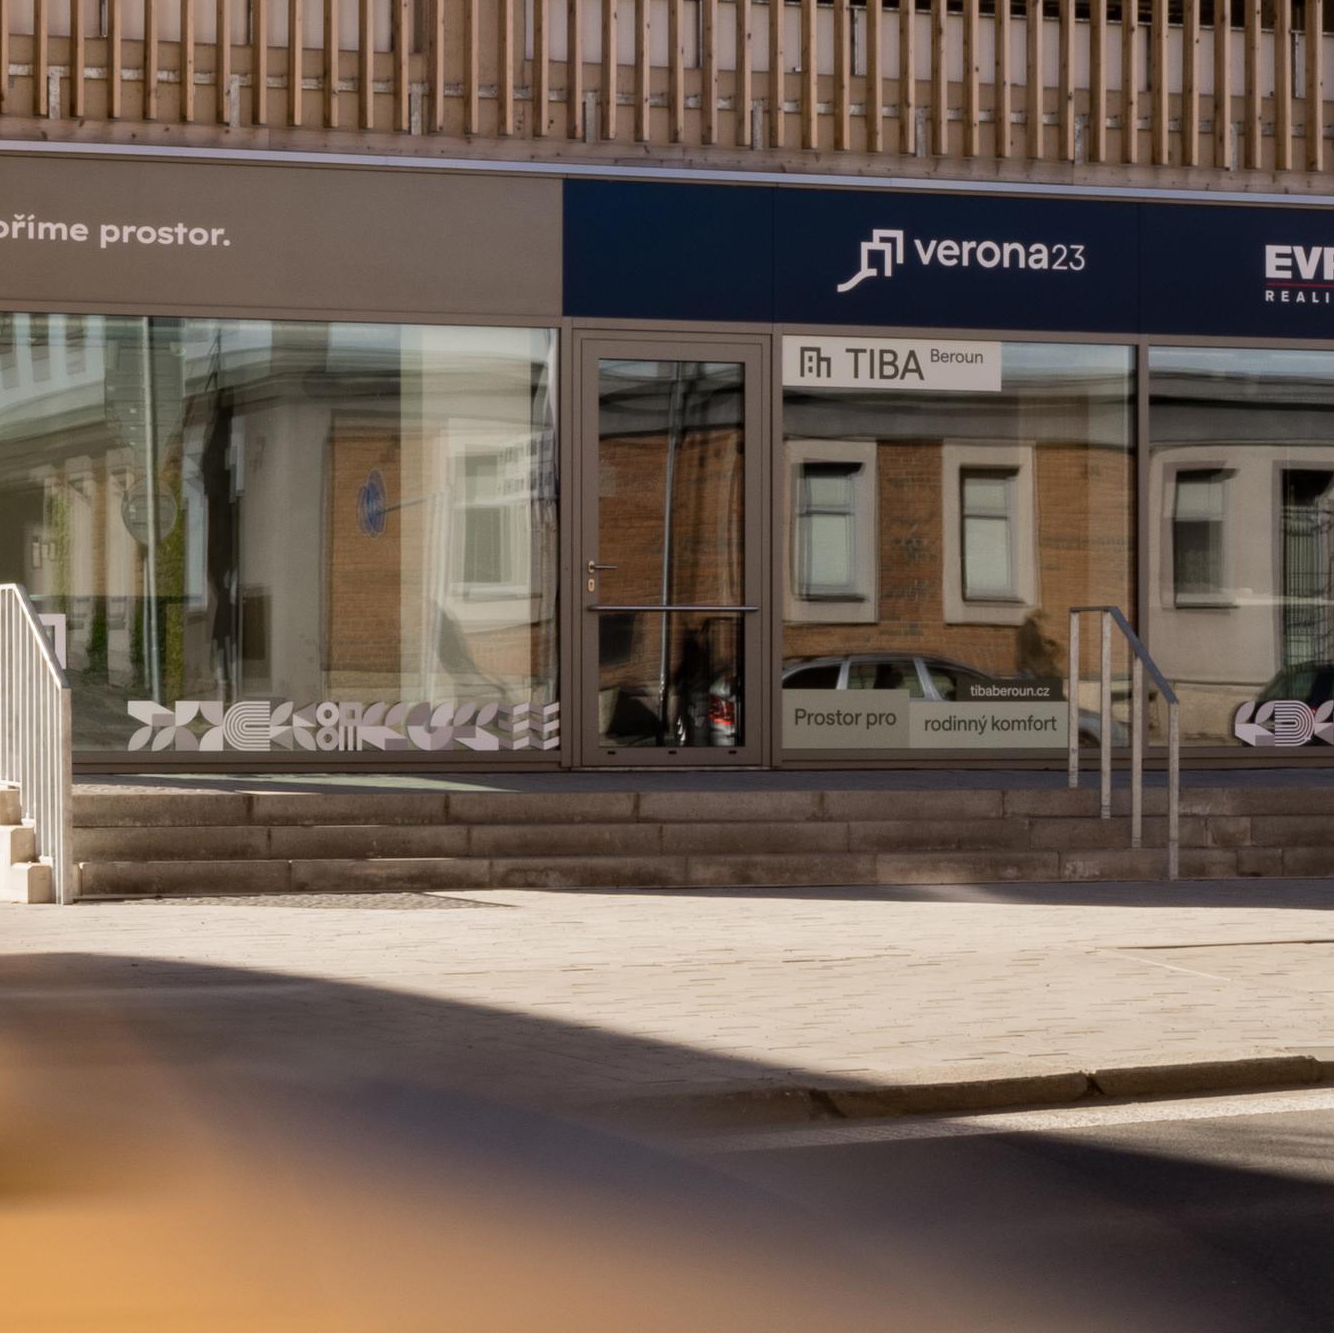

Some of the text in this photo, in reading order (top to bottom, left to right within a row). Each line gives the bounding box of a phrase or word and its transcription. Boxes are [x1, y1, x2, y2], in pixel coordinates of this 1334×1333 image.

[99, 222, 231, 249] prostor.
[914, 238, 1086, 271] verona23
[845, 347, 984, 381] TIBA Beroun
[970, 684, 1050, 697] tibaberoun.cz
[794, 708, 1058, 735] Prostor pro rodinný komfort
